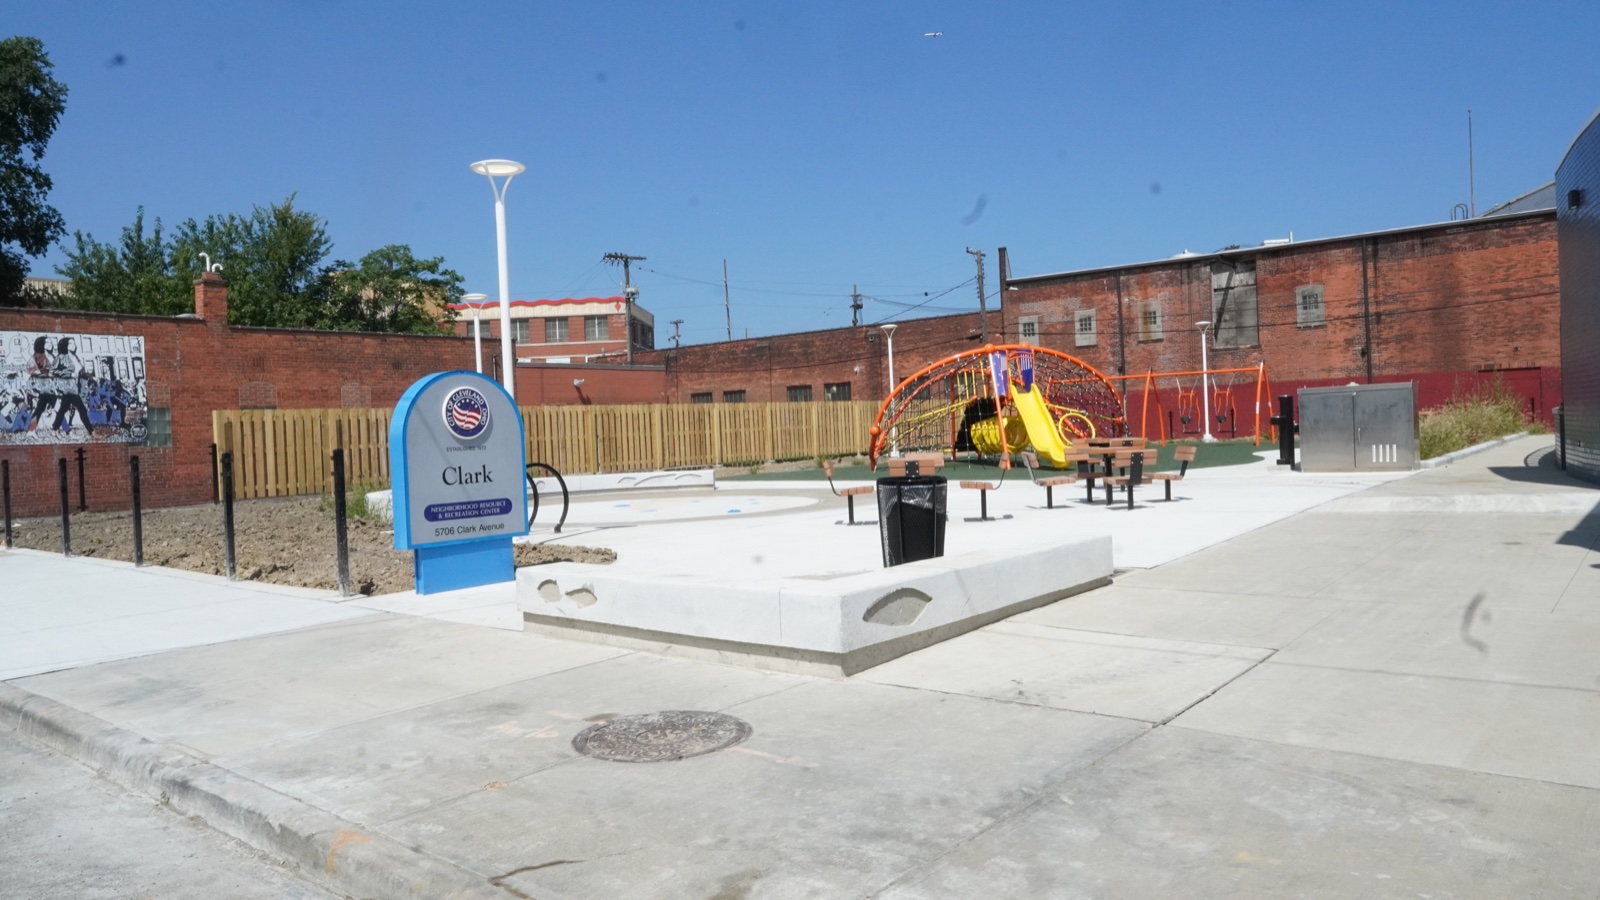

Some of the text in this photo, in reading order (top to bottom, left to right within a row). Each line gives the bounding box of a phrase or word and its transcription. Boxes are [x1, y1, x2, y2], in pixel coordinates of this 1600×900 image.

[447, 390, 488, 427] CITY OF CLEVELAND OHIO
[442, 464, 493, 486] Clark
[430, 500, 506, 513] NEIGHBORHOOD RESOURCE
[444, 509, 479, 519] RECREATION
[480, 507, 501, 515] CENTER
[435, 522, 505, 537] 5706 Clark Avenue
